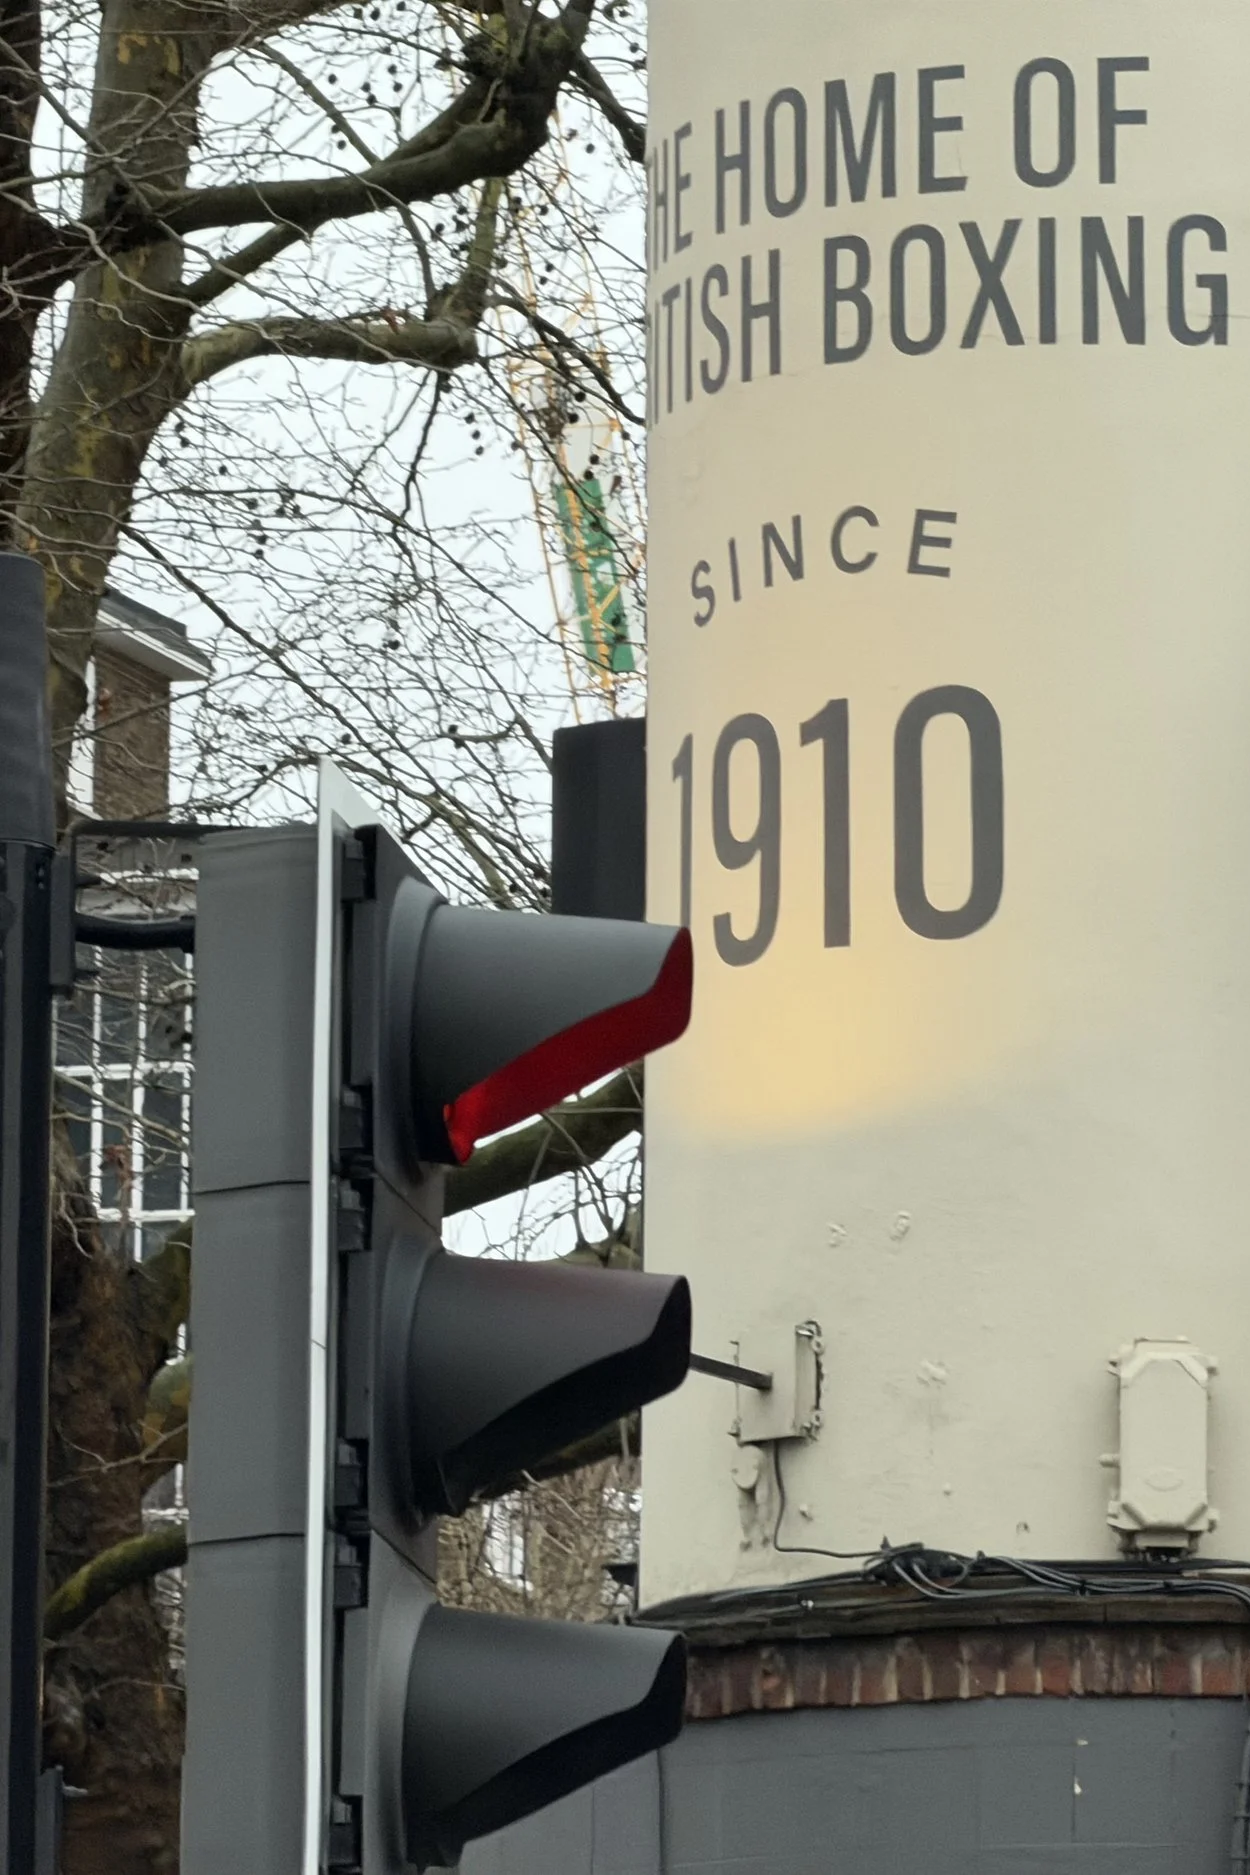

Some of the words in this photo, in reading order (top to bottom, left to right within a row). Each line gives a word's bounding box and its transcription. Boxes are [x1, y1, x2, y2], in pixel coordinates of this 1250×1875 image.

[715, 65, 968, 234] HOME
[1013, 56, 1149, 188] OF
[647, 248, 781, 430] ITISH
[824, 213, 1229, 365] BOXING
[691, 505, 957, 627] SINCE
[672, 685, 1004, 967] 1910
